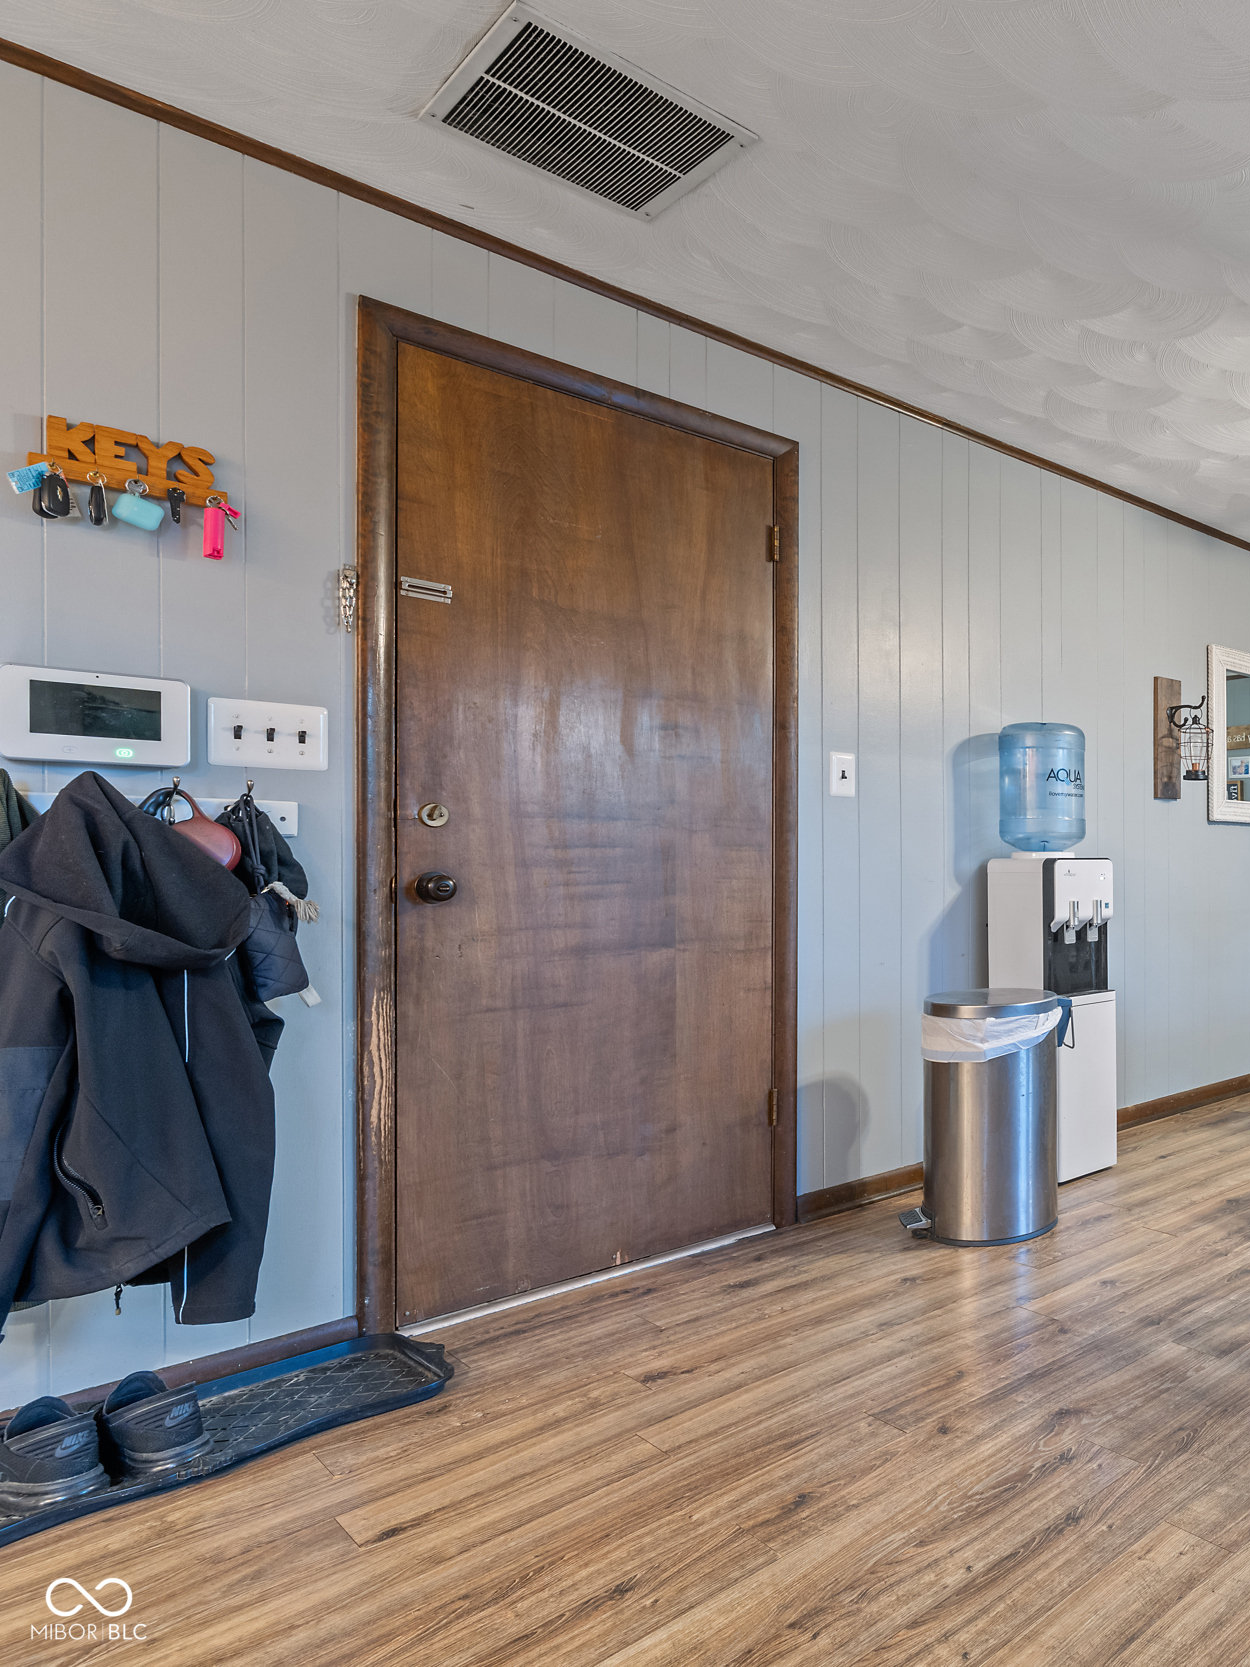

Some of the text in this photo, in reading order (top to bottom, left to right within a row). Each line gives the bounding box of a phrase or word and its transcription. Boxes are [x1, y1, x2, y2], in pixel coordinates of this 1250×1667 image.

[46, 414, 217, 490] KEYS
[1046, 768, 1082, 786] AQUA
[170, 1400, 196, 1418] NIKE
[61, 1430, 90, 1448] NIKE
